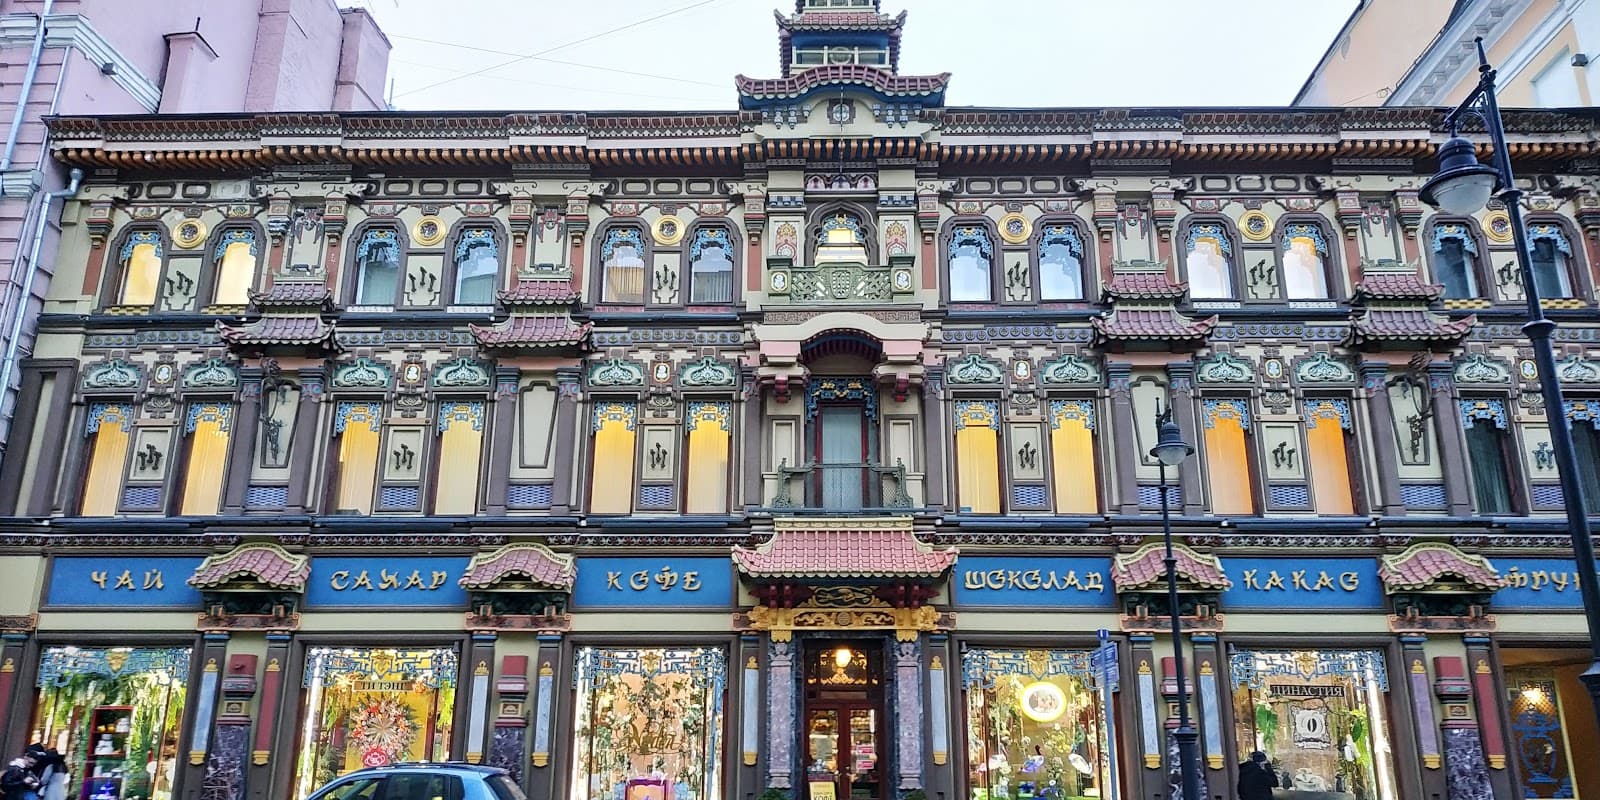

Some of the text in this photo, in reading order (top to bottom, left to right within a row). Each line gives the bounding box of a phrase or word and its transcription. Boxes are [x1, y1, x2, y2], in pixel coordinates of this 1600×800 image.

[91, 568, 164, 590] ЧАЙ
[331, 568, 447, 590] САХАР
[607, 565, 701, 591] КОФЕ
[965, 569, 1104, 592] ШОКОЛАД
[1243, 569, 1359, 591] КАКАО
[1272, 685, 1343, 696] ДИНАСТИЯ
